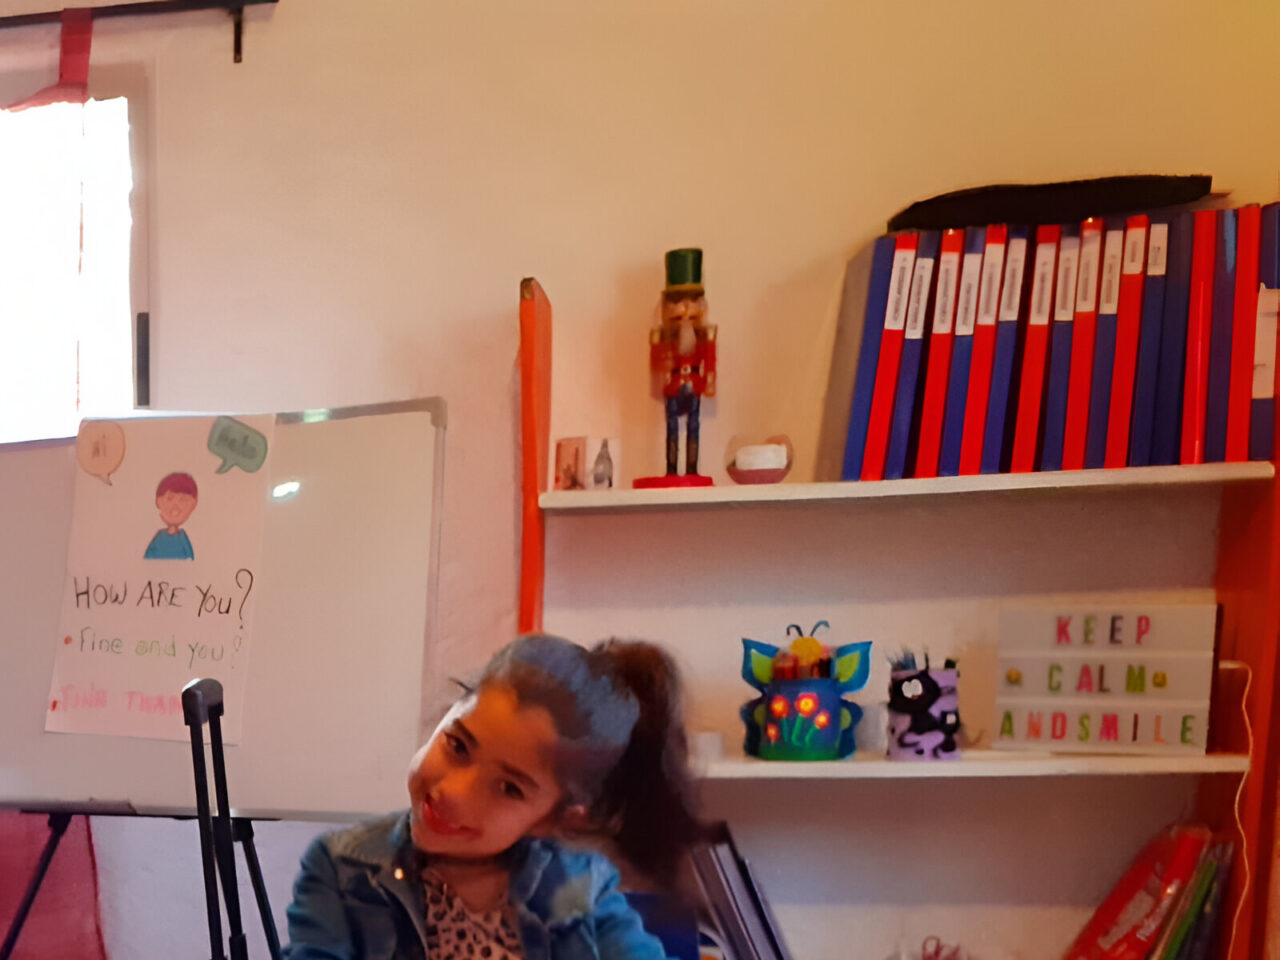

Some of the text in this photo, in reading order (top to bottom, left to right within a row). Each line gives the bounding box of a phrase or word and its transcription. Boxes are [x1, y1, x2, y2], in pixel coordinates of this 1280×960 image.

[74, 576, 128, 609] HOW
[136, 580, 186, 608] ARE
[1056, 615, 1151, 645] KEEP
[135, 635, 177, 657] and
[1048, 664, 1147, 694] CALM
